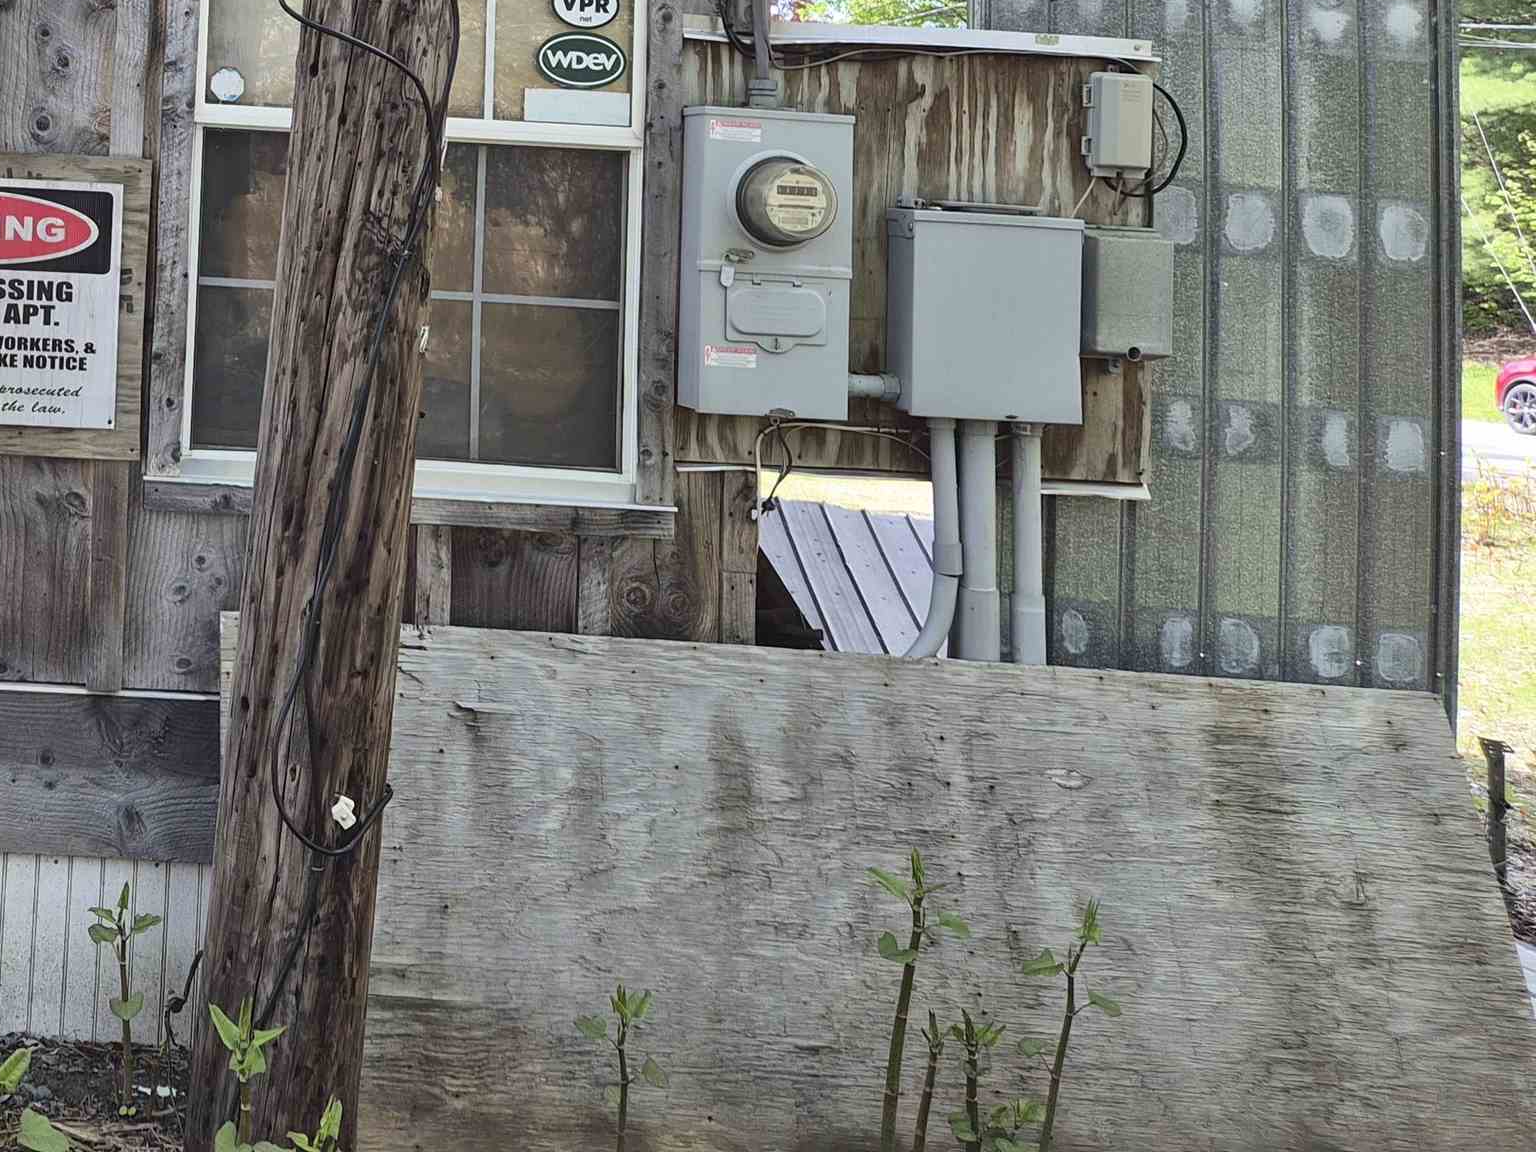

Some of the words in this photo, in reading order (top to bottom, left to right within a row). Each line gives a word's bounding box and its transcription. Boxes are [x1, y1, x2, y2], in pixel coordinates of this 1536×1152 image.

[2, 304, 60, 327] APT.
[84, 341, 97, 354] &
[22, 354, 88, 372] NOTICE
[1, 400, 25, 413] the
